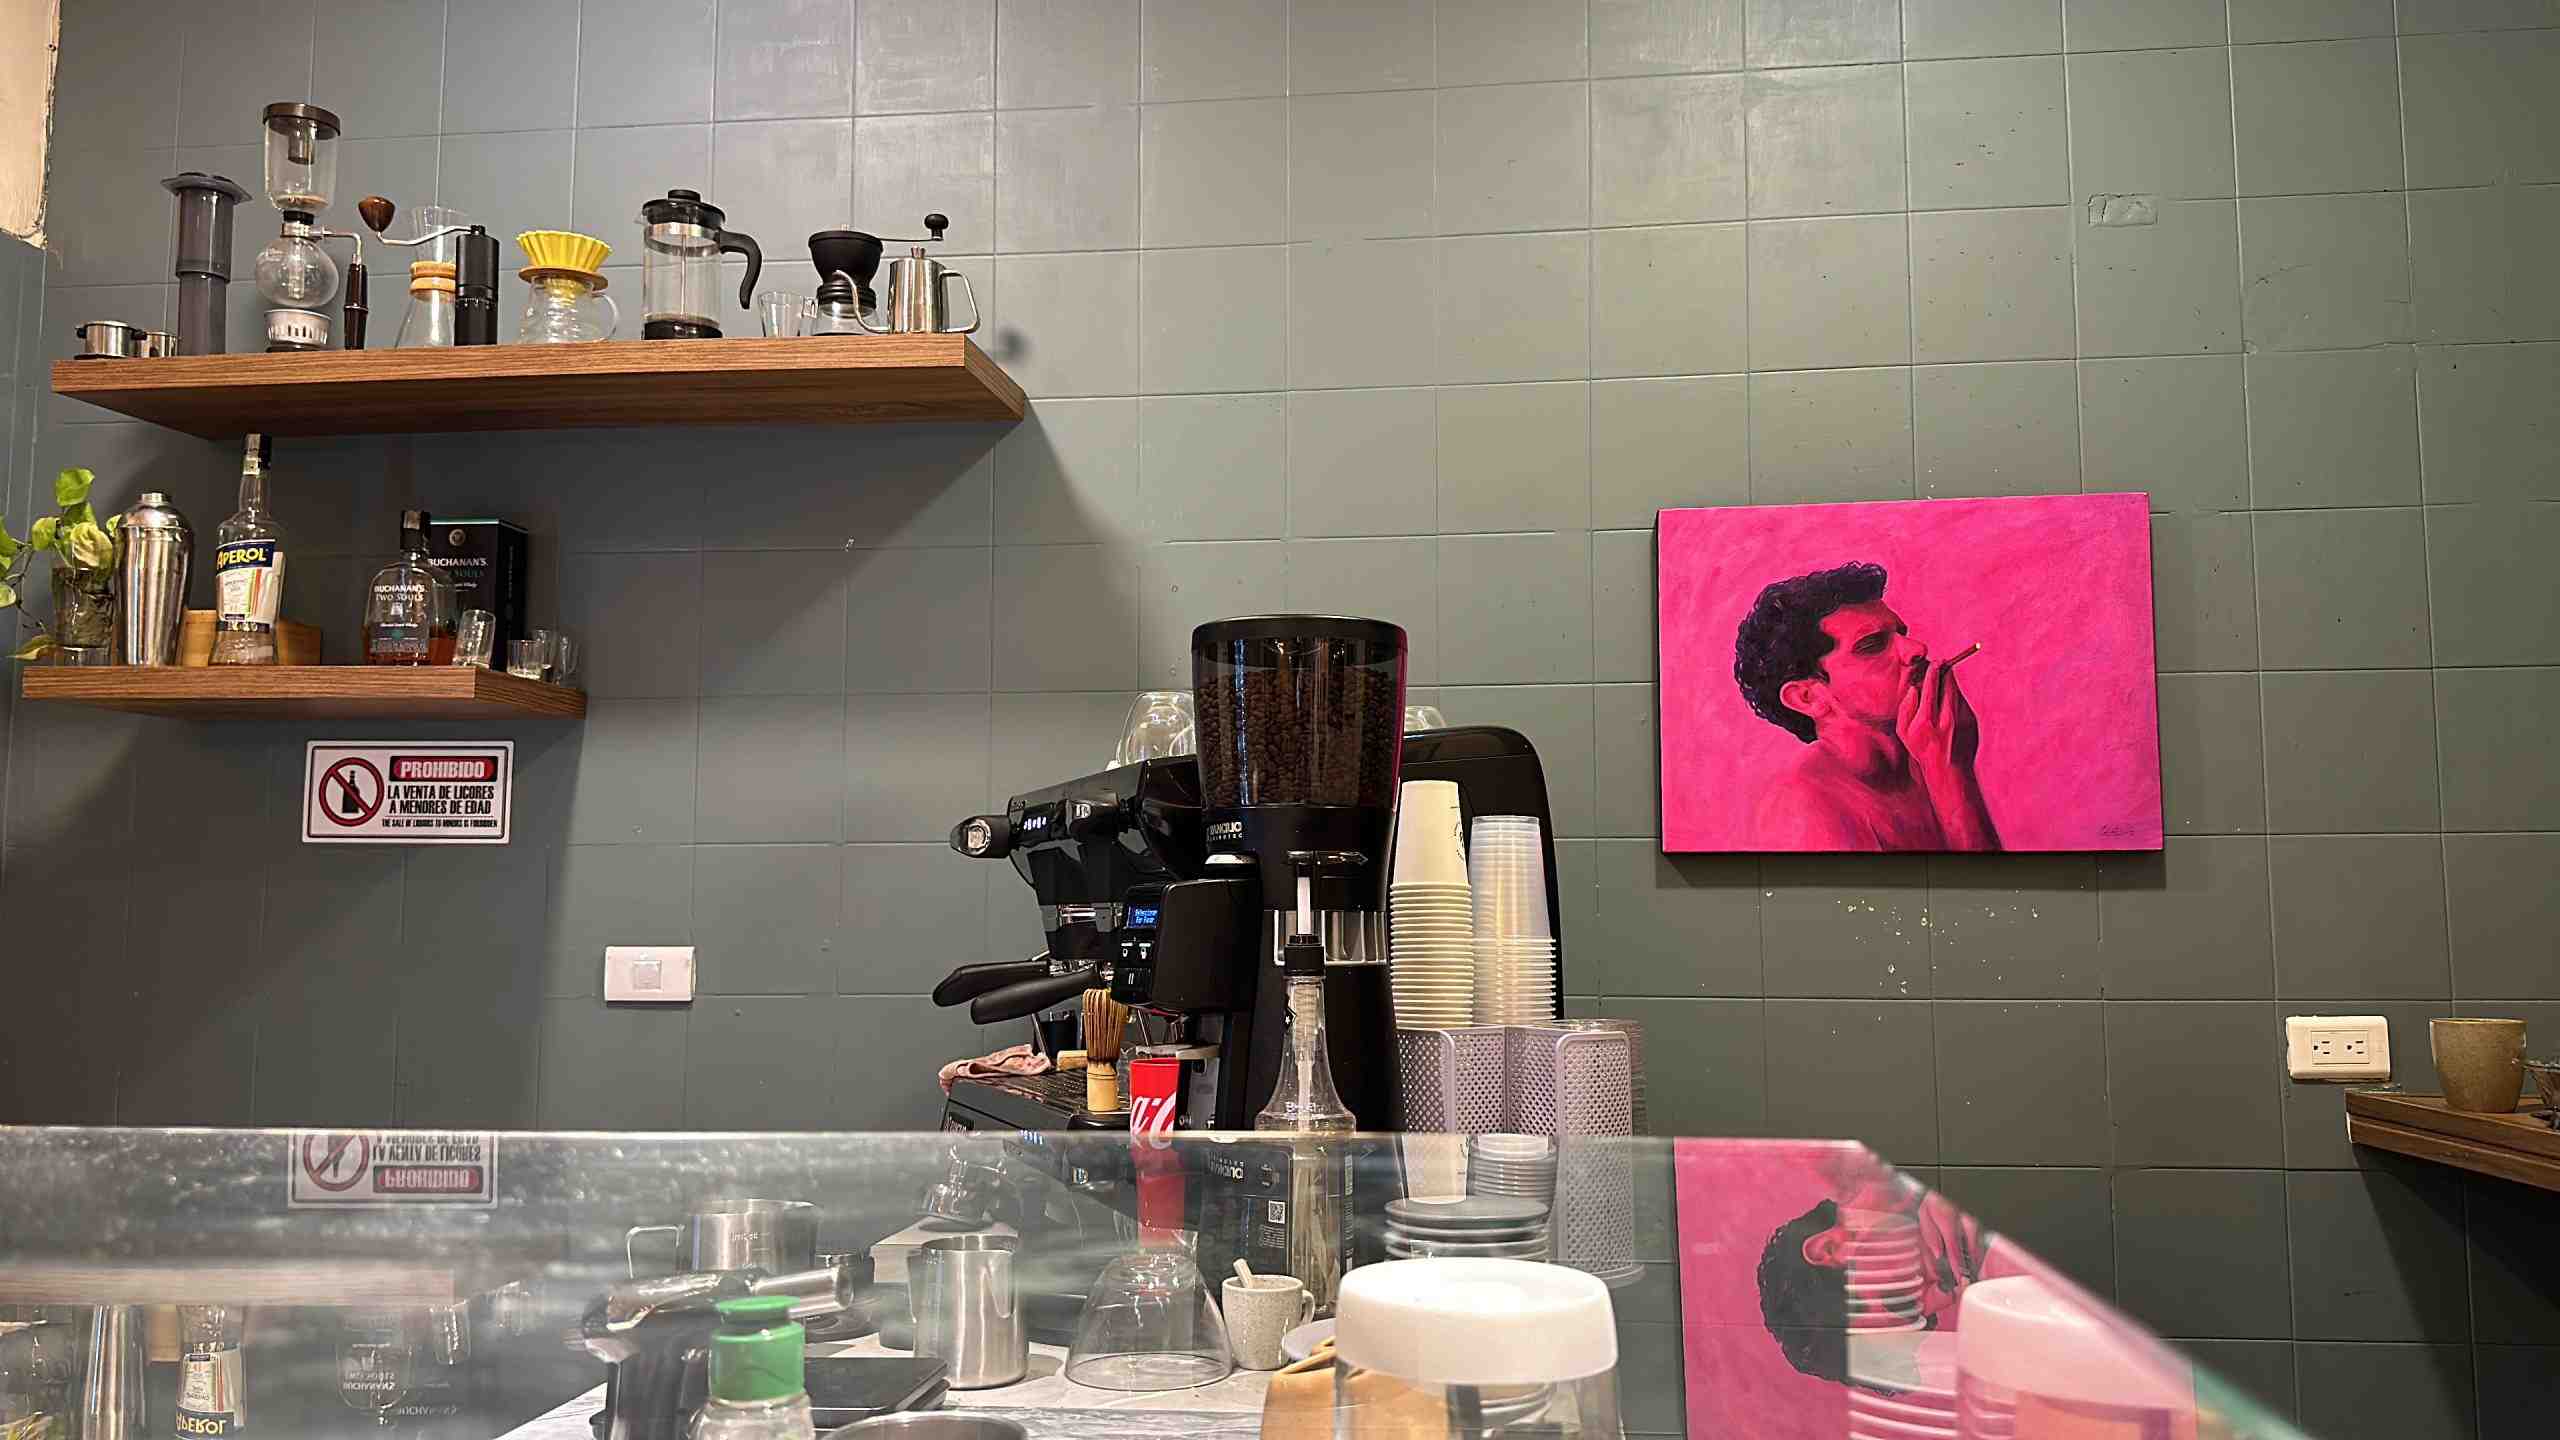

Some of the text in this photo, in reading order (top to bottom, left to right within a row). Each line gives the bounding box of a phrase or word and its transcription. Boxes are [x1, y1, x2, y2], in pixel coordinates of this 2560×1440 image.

[216, 548, 267, 570] APEROL
[400, 761, 485, 778] PROHIBIDO
[387, 785, 494, 800] LA VENTA DE LICORES
[389, 800, 491, 814] A MENORES DE EDAD
